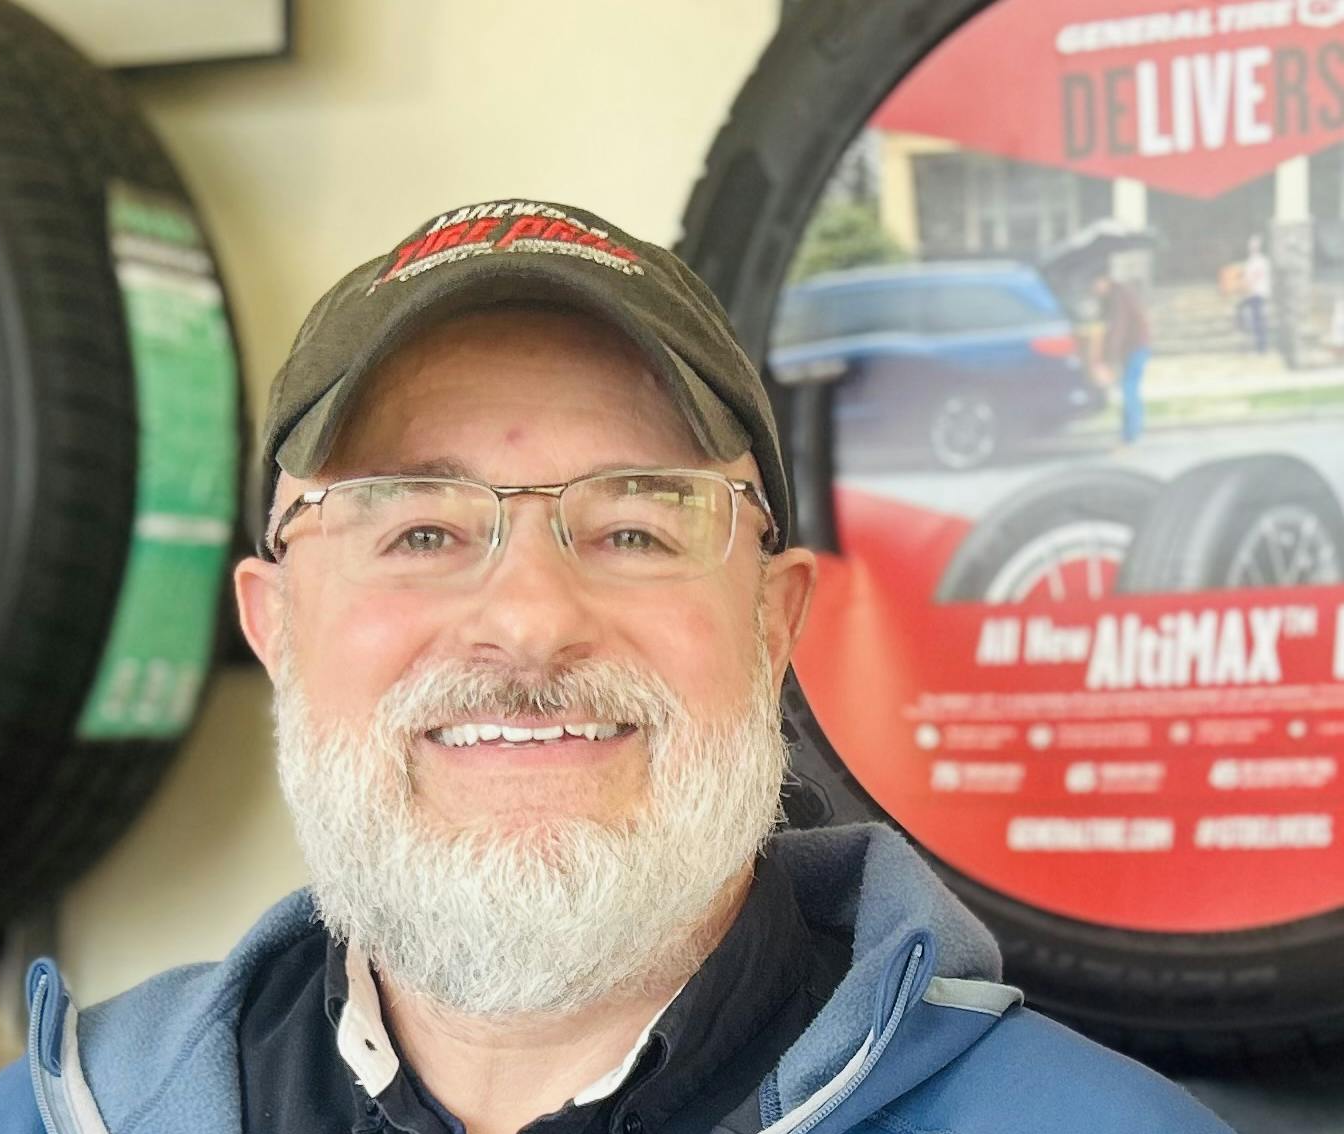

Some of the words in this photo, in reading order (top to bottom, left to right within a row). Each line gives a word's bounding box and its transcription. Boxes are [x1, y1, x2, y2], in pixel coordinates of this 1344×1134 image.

[1057, 9, 1214, 53] GENERAL
[1216, 0, 1293, 33] TIRE
[383, 215, 502, 285] TIRE
[975, 617, 1022, 666] All
[1024, 616, 1090, 664] New
